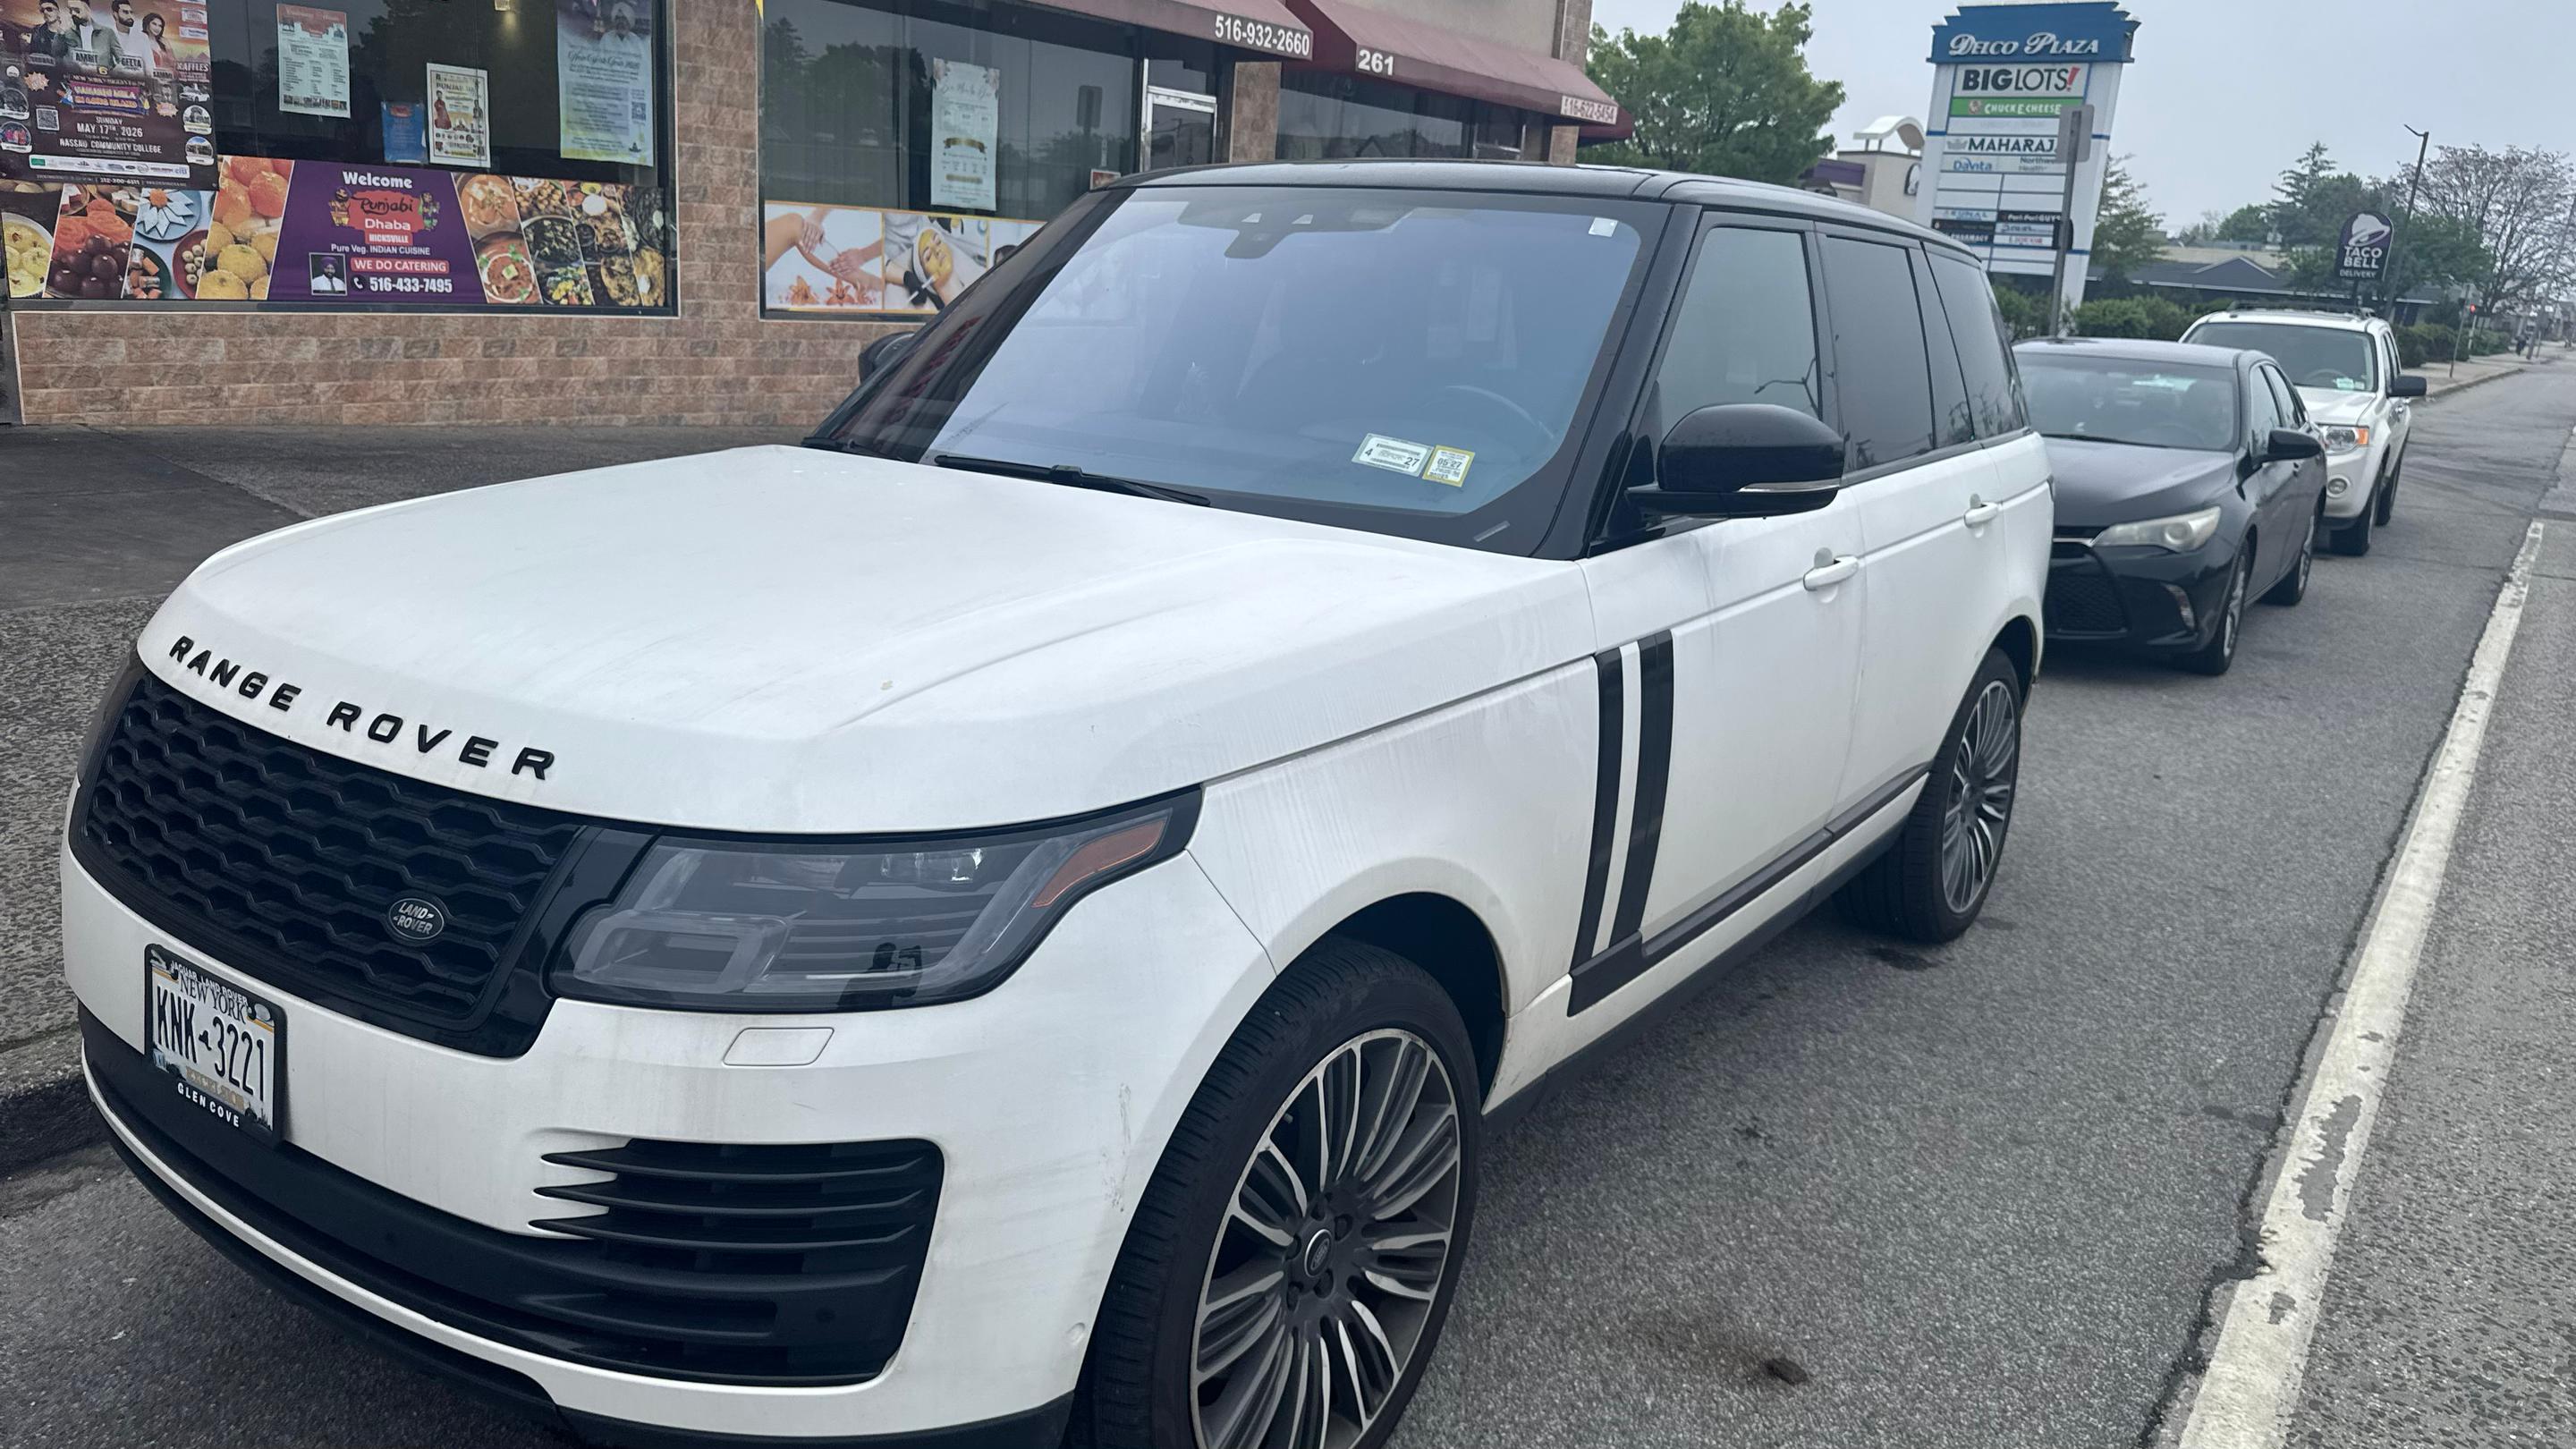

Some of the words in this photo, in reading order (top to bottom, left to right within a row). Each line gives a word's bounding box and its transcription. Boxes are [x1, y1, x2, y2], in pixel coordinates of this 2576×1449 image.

[1215, 14, 1310, 55] 516-932-2660
[1358, 49, 1394, 75] 261
[96, 116, 123, 125] SUNDAY
[77, 123, 96, 133] MAY
[121, 127, 143, 138] 2026
[90, 140, 131, 152] COMMUNITY
[133, 143, 162, 154] COLLEGE
[1968, 138, 2059, 153] MAHARAJ
[343, 171, 413, 189] Welcome
[354, 195, 413, 216] Punjabi
[365, 217, 411, 231] Dhaba
[331, 243, 350, 253] Pure
[351, 244, 369, 255] Veg.
[369, 245, 397, 255] INDIAN
[399, 246, 430, 256] CUISINE
[2344, 246, 2383, 258] TACO
[354, 260, 374, 270] WE
[376, 261, 392, 271] DO
[394, 261, 446, 272] CATERING
[2343, 256, 2379, 268] BELL
[2339, 269, 2377, 278] DELIVERY
[369, 277, 453, 293] 516-433-7495
[1364, 448, 1373, 456] 4
[1404, 457, 1419, 467] 27
[168, 635, 301, 712] RANGE
[326, 700, 555, 781] ROVER
[396, 914, 433, 935] ROVER
[170, 961, 199, 983] JAGUAR
[180, 972, 209, 1004] NEW
[209, 987, 246, 1025] YORK
[157, 985, 198, 1063] KNK
[213, 1016, 264, 1102] 3221
[178, 1082, 206, 1108] GLEN
[209, 1100, 240, 1127] COVE
